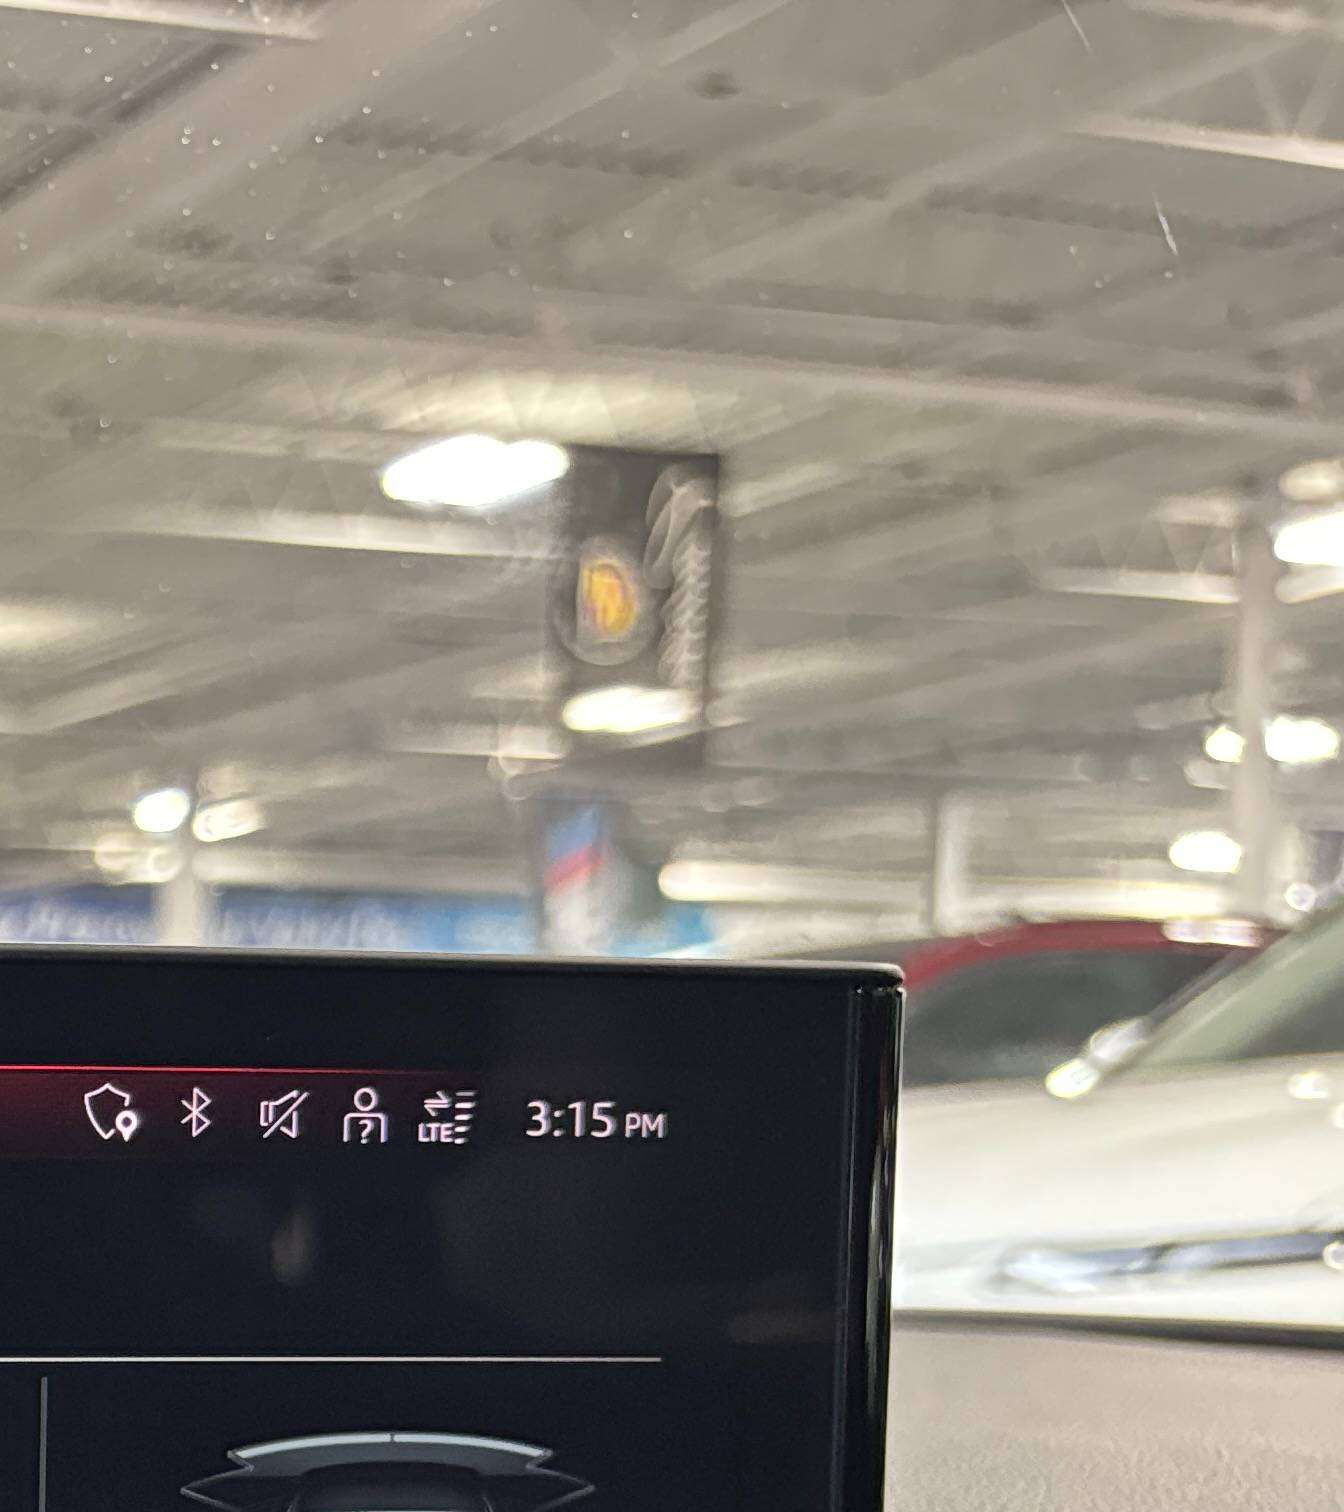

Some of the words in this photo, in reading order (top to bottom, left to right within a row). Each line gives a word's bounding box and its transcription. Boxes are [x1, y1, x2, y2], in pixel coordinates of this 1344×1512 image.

[418, 1122, 455, 1143] LTE
[525, 1100, 616, 1139] 3:15
[623, 1112, 666, 1140] PM
